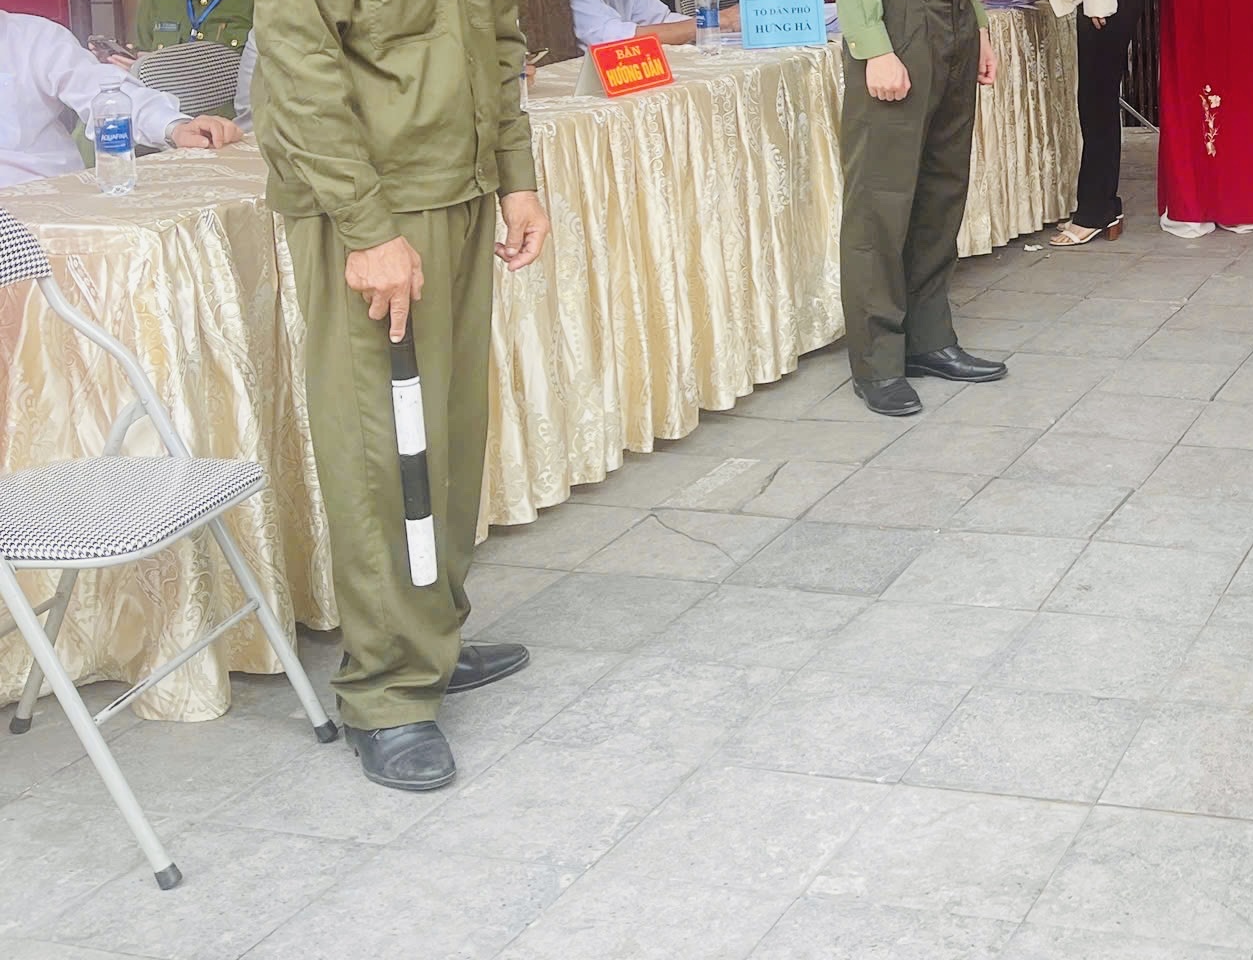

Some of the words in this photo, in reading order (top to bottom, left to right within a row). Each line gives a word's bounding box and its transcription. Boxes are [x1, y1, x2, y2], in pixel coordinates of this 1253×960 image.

[755, 22, 791, 33] HƯNG
[606, 62, 644, 87] HƯỚNG
[101, 133, 129, 142] AQUAFINA
